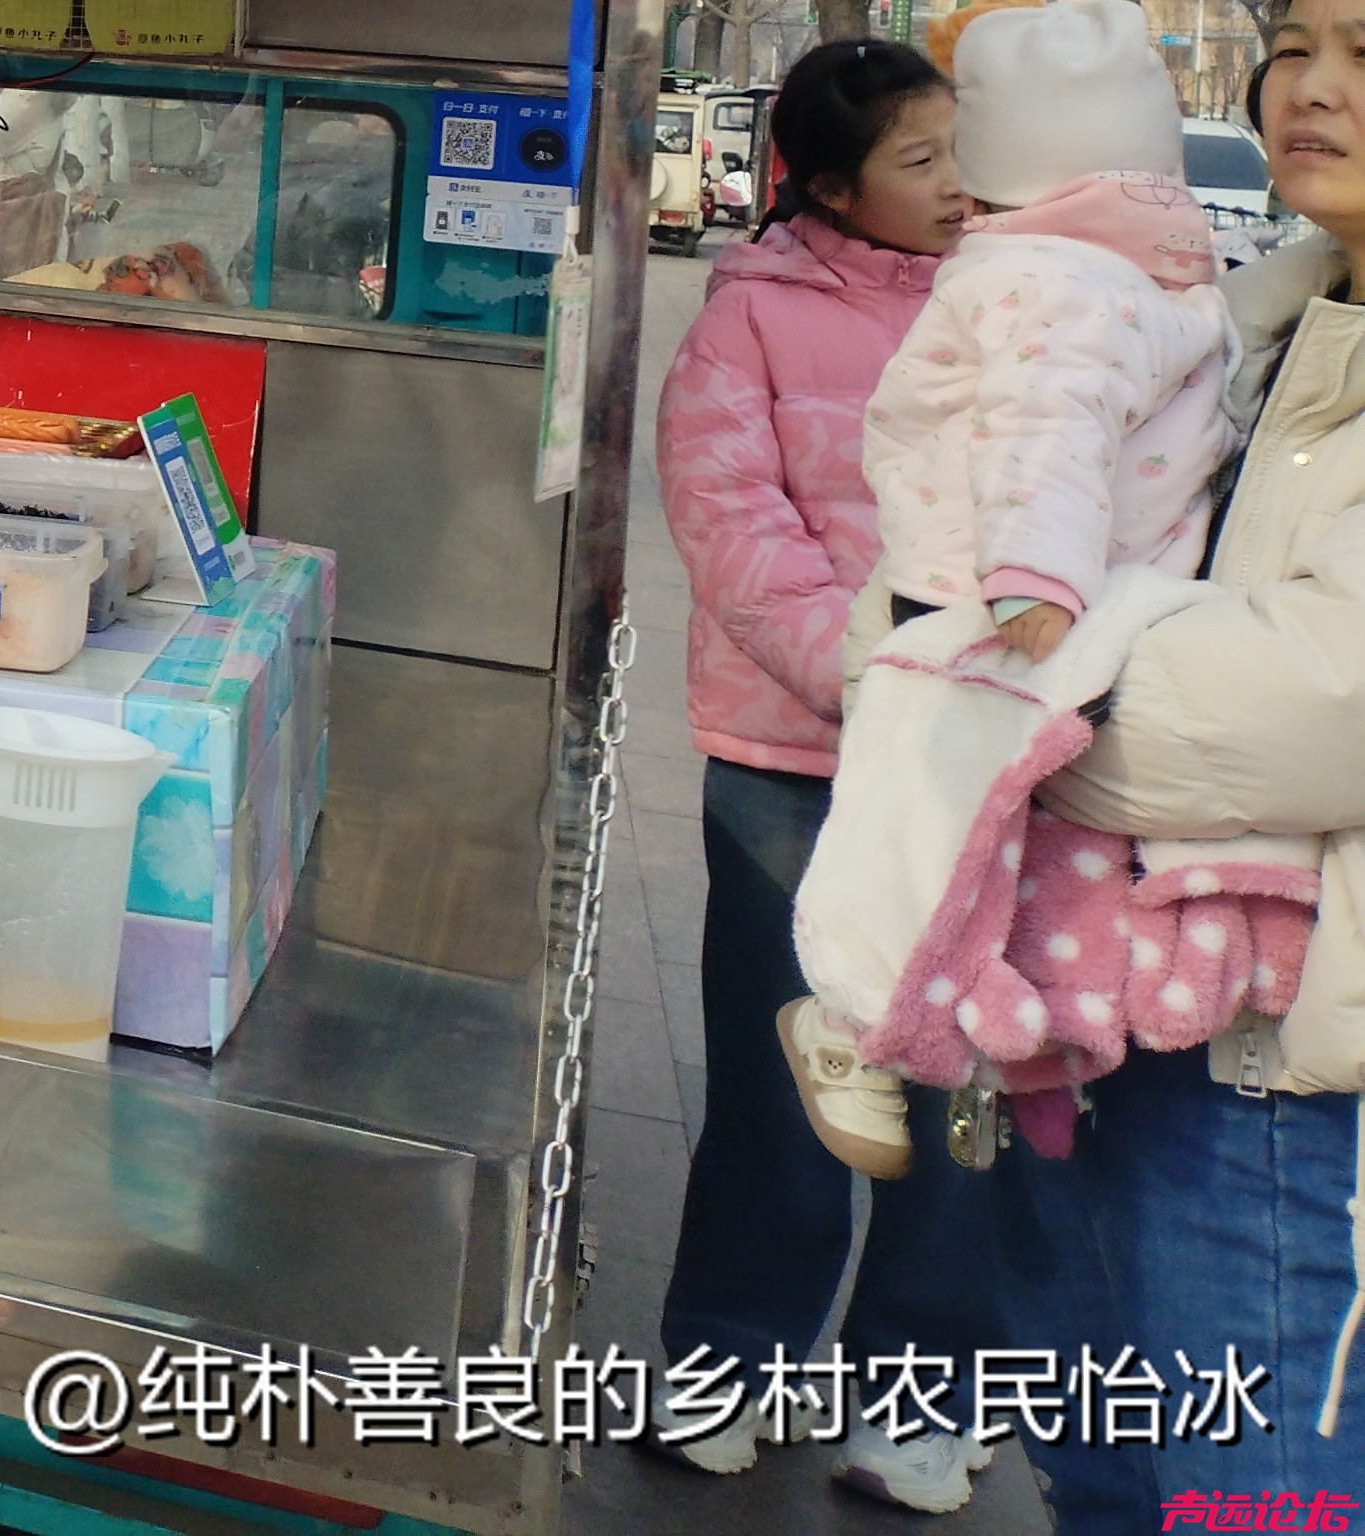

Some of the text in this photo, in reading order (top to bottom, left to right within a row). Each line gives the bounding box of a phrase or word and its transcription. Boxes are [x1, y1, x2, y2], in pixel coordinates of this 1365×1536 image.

[137, 32, 205, 45] 章鱼小丸子
[443, 101, 499, 115] 扫一扫 支付
